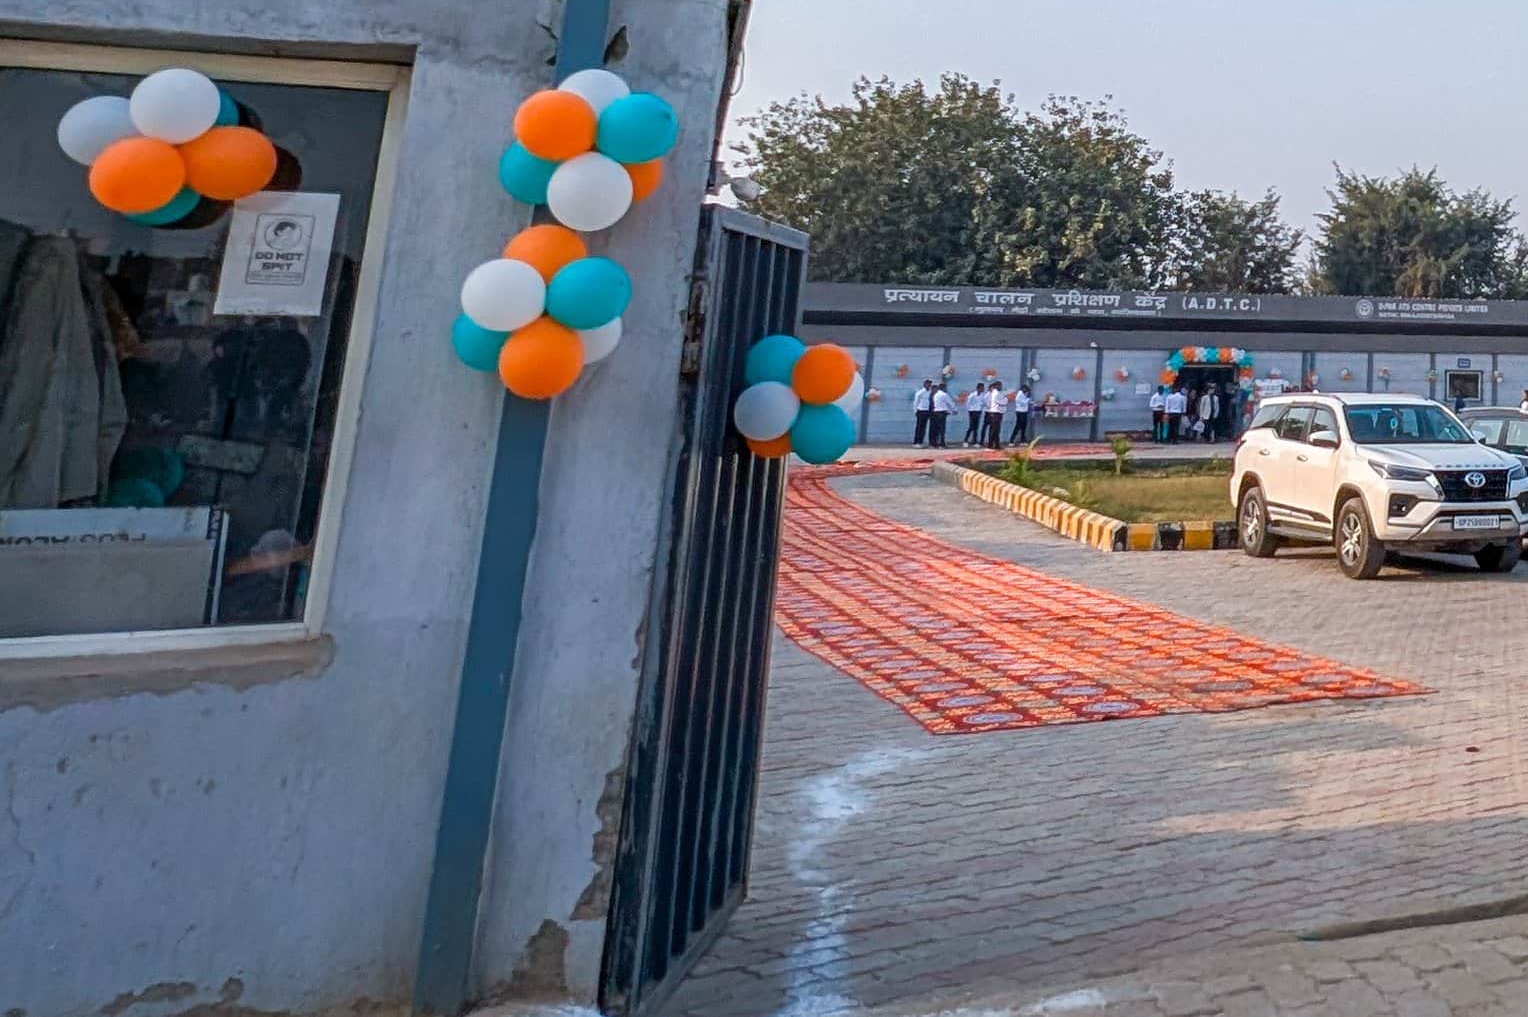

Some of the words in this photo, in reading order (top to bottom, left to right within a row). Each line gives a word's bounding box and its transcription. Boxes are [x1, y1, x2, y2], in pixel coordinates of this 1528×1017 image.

[255, 252, 273, 261] DO
[276, 252, 304, 261] NOT
[262, 262, 292, 271] SPIT
[884, 289, 960, 303] प्रत्यायन
[974, 291, 1035, 305] चालन
[1052, 290, 1121, 308] प्रशिक्षण
